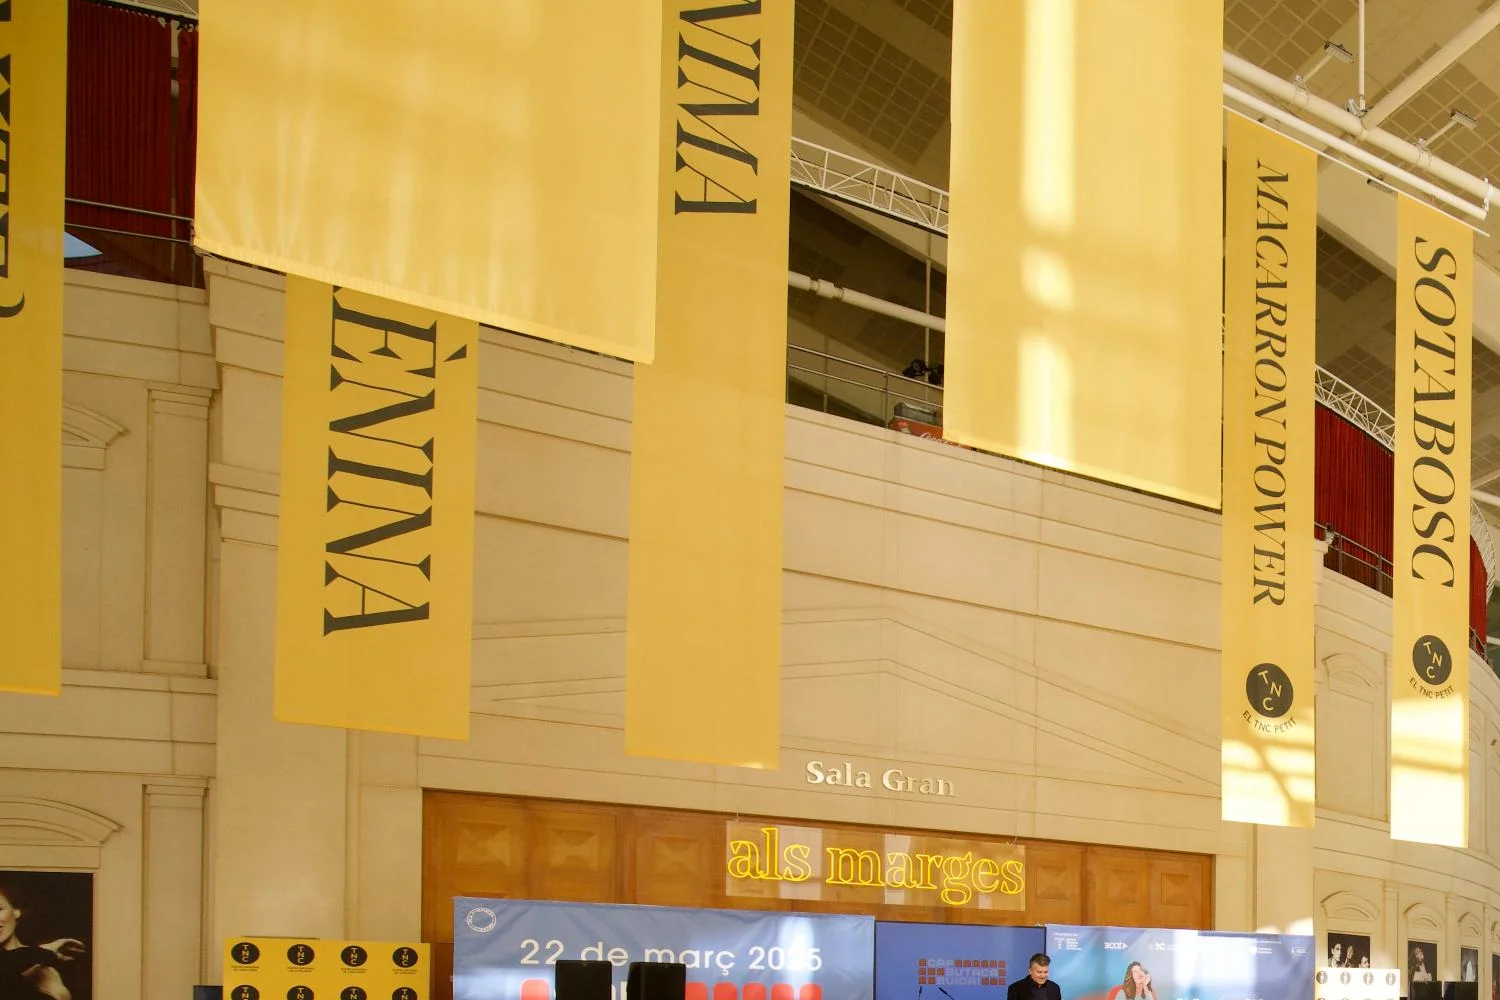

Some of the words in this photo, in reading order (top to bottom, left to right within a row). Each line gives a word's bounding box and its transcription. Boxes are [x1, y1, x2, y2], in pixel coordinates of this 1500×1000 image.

[1255, 158, 1289, 429] MACARRON
[323, 285, 467, 637] ÈNINA
[1411, 236, 1458, 588] SOTABOSC
[1252, 432, 1287, 606] POWER
[806, 761, 872, 789] Sala
[882, 769, 955, 797] Gran
[728, 828, 812, 881] als
[826, 847, 1026, 905] marges
[520, 939, 565, 965] 22
[581, 942, 629, 967] de
[645, 948, 736, 976] març
